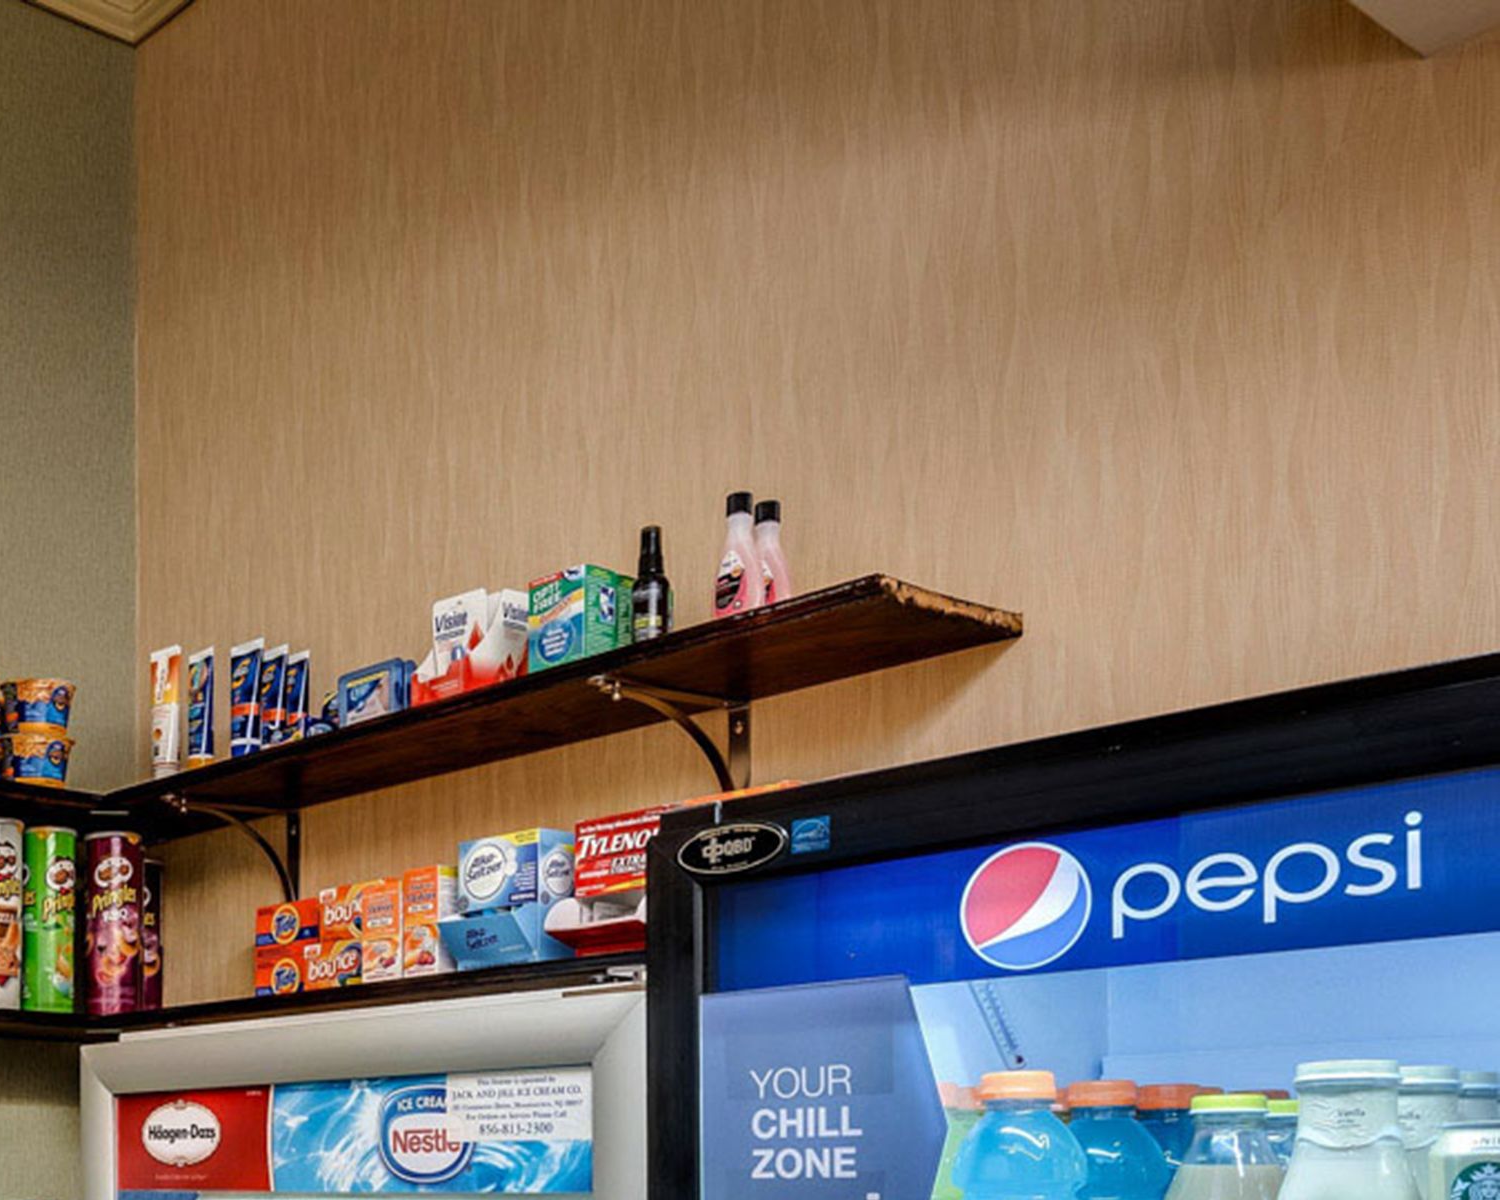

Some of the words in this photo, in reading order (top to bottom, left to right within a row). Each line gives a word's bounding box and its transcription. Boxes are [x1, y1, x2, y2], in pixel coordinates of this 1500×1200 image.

[434, 611, 468, 633] Visine
[466, 862, 503, 883] Seltzer
[1111, 810, 1424, 939] pepsi
[274, 909, 297, 936] Tide
[274, 965, 297, 992] Tide
[308, 949, 358, 982] bounce
[452, 1090, 473, 1100] JACK
[476, 1089, 496, 1099] AND
[497, 1089, 514, 1100] JILL
[517, 1087, 531, 1097] ICE
[533, 1086, 565, 1096] CREAM
[749, 1063, 852, 1098] YOUR
[397, 1098, 415, 1112] ICE
[416, 1096, 447, 1112] CREA
[148, 1122, 217, 1145] Häagen-Dazs
[751, 1106, 863, 1139] CHILL
[751, 1147, 858, 1180] ZONE
